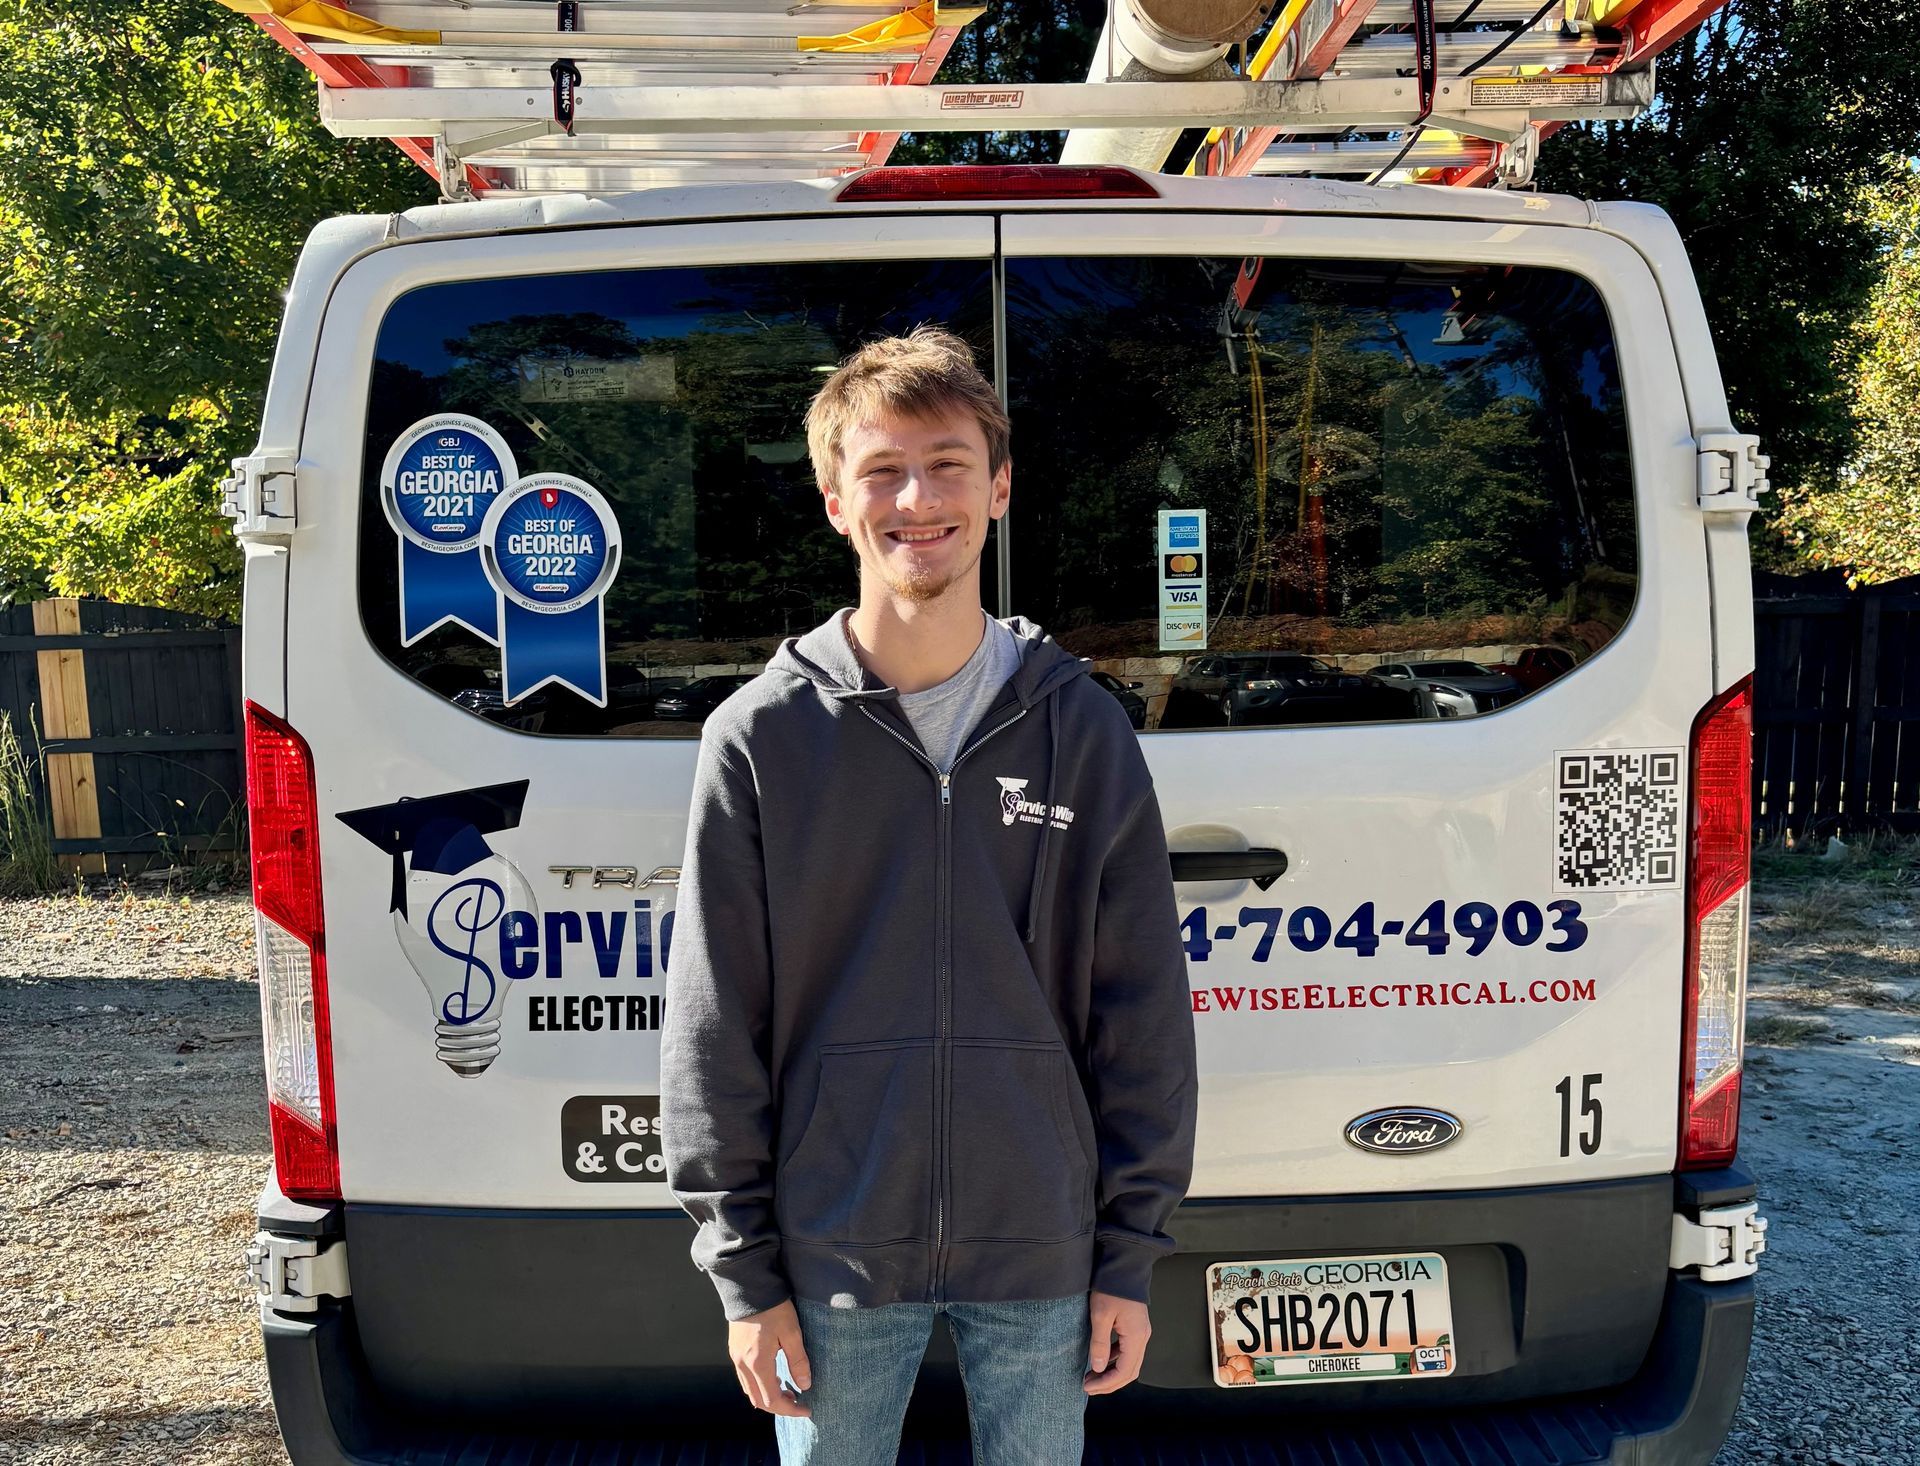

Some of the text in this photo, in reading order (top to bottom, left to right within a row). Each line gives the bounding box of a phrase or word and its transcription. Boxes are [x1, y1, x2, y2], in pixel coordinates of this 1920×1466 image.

[1423, 54, 1431, 70] 500
[561, 71, 570, 99] HUSKY
[944, 91, 1019, 105] weather guard
[411, 422, 435, 438] GEORGIA
[440, 438, 460, 447] GBJ
[422, 455, 475, 469] BEST OF
[400, 470, 498, 495] GEORGIA
[509, 482, 533, 498] GEORGIA
[423, 495, 474, 517] 2021
[525, 519, 575, 532] BEST OF
[508, 534, 593, 555] GEORGIA
[525, 556, 577, 576] 2022
[1170, 592, 1198, 602] VISA
[1166, 622, 1201, 630] DISCOVER
[529, 995, 667, 1031] ELECTRI
[1555, 1073, 1603, 1158] 15
[1373, 1117, 1437, 1145] Ford
[575, 1141, 608, 1174] &
[1223, 1260, 1432, 1289] Peach State GEORGIA
[1234, 1288, 1418, 1354] SHB2071
[1308, 1349, 1441, 1373] CHEROKEE OCT
[1435, 1361, 1446, 1369] 25
